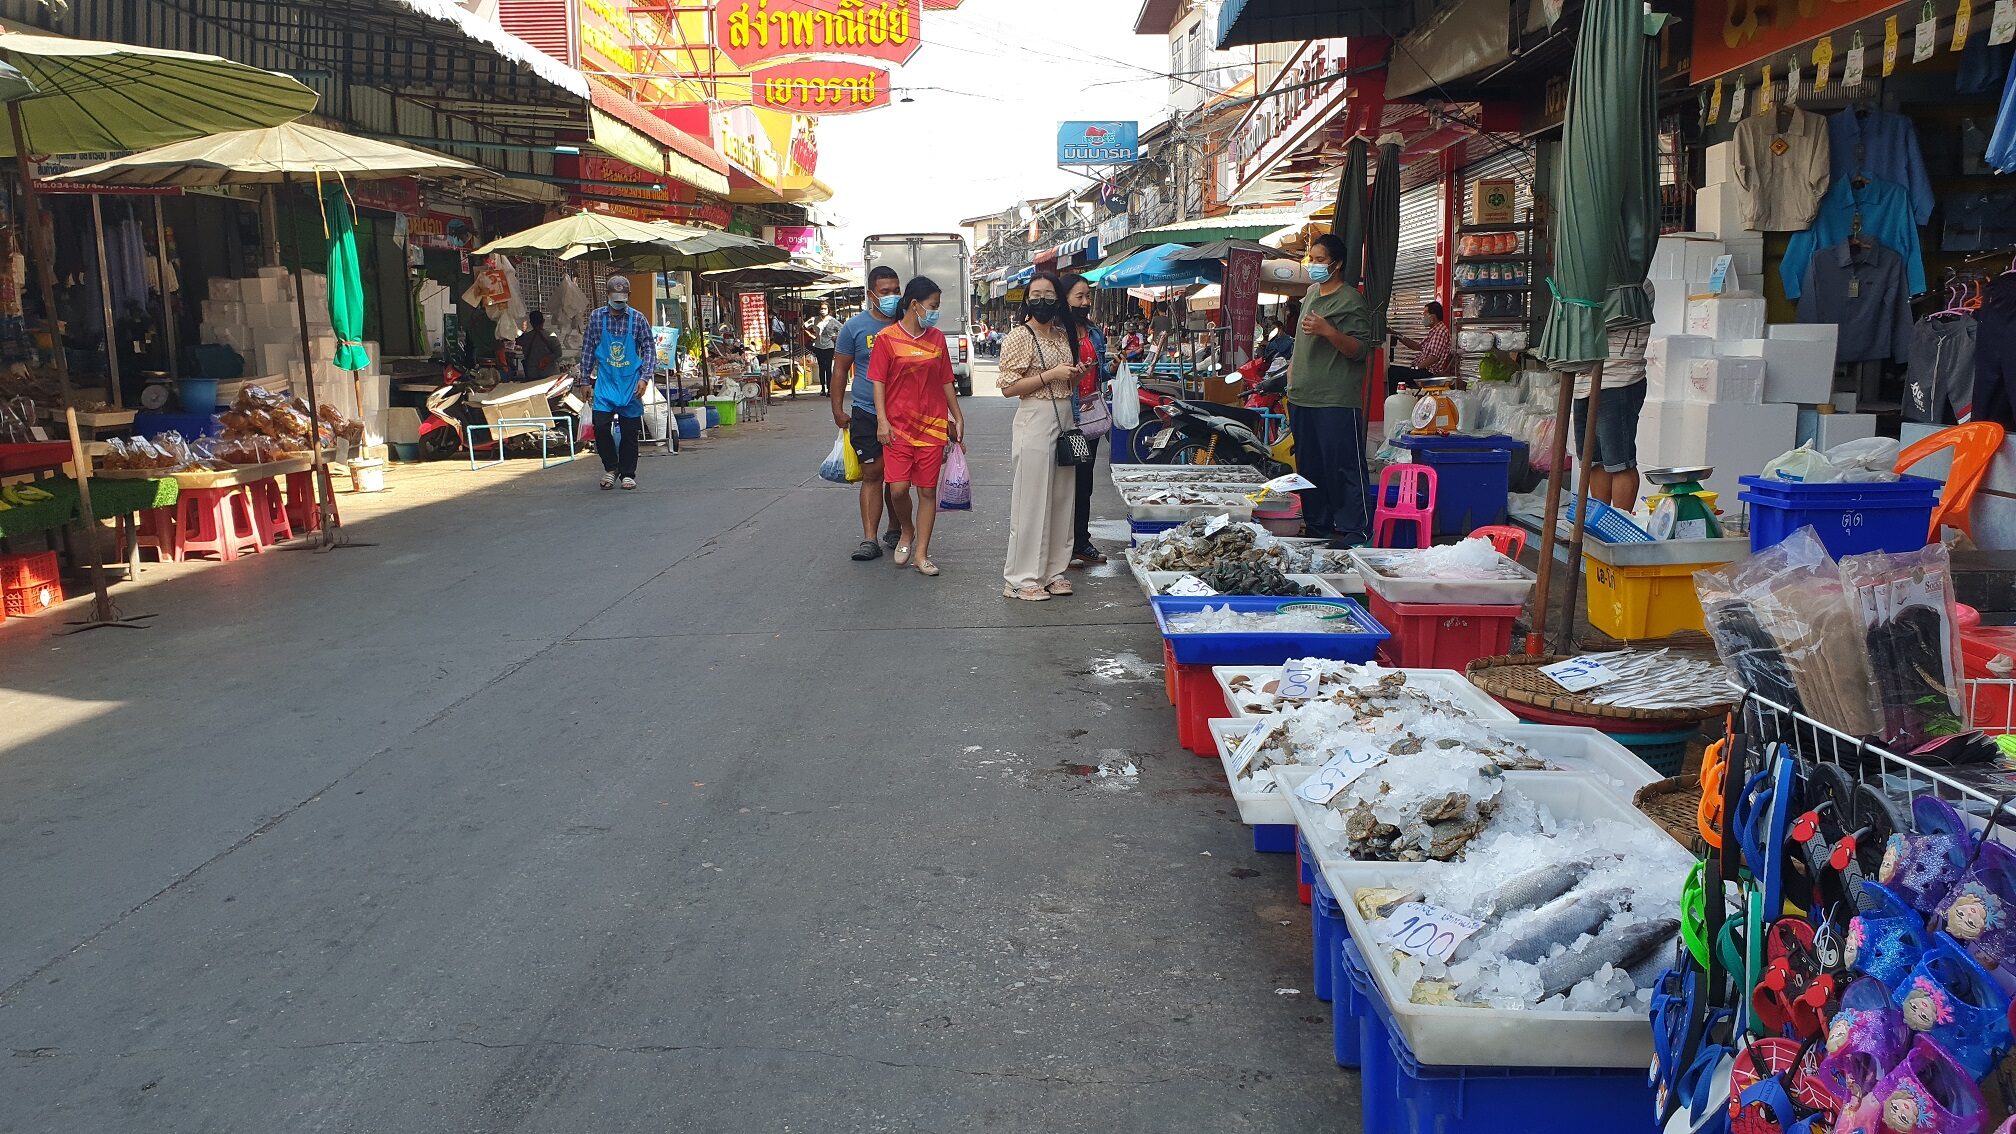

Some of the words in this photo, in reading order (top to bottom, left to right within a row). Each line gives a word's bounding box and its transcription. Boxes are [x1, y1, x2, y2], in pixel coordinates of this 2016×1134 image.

[765, 71, 877, 104] เยาวราช
[1281, 666, 1313, 697] 100
[1393, 916, 1455, 957] 100
